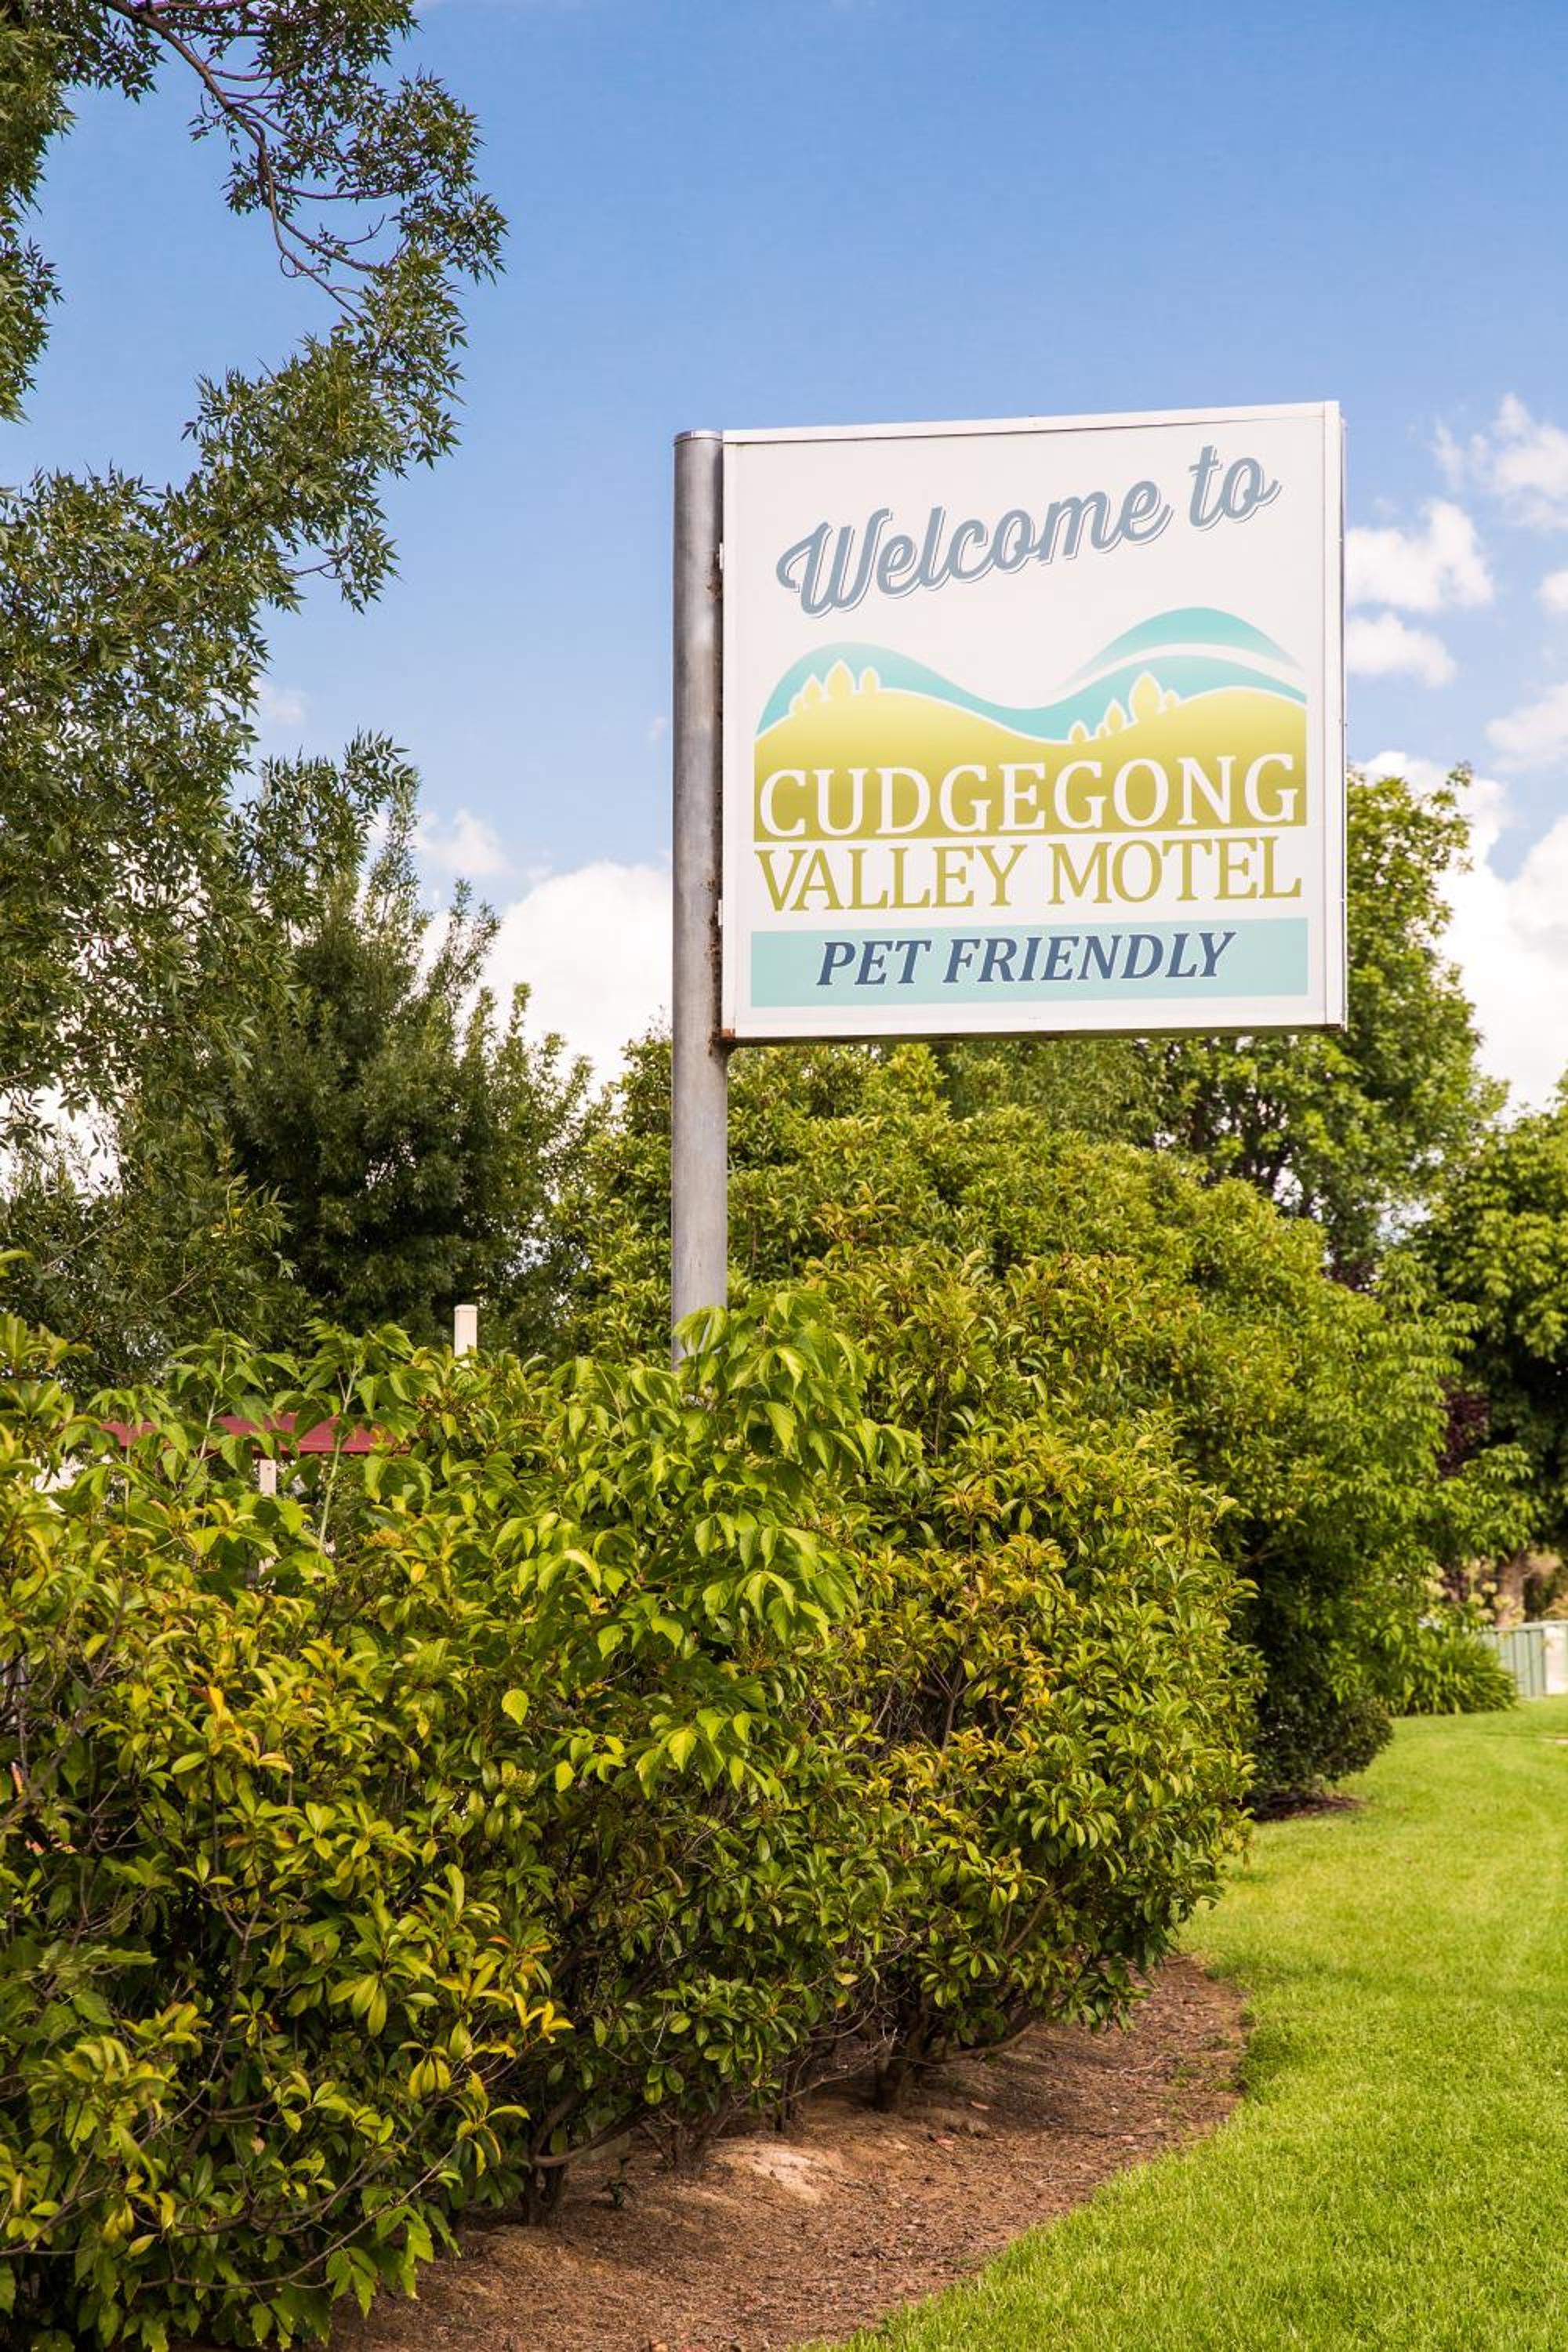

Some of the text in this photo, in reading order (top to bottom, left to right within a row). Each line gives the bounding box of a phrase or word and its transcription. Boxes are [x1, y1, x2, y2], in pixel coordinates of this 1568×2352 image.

[776, 445, 1282, 619] Welcome to
[759, 753, 1300, 837] CUDGEGONG
[754, 836, 1303, 912] VALLEY MOTEL
[815, 931, 1237, 986] PET FRIENDLY
